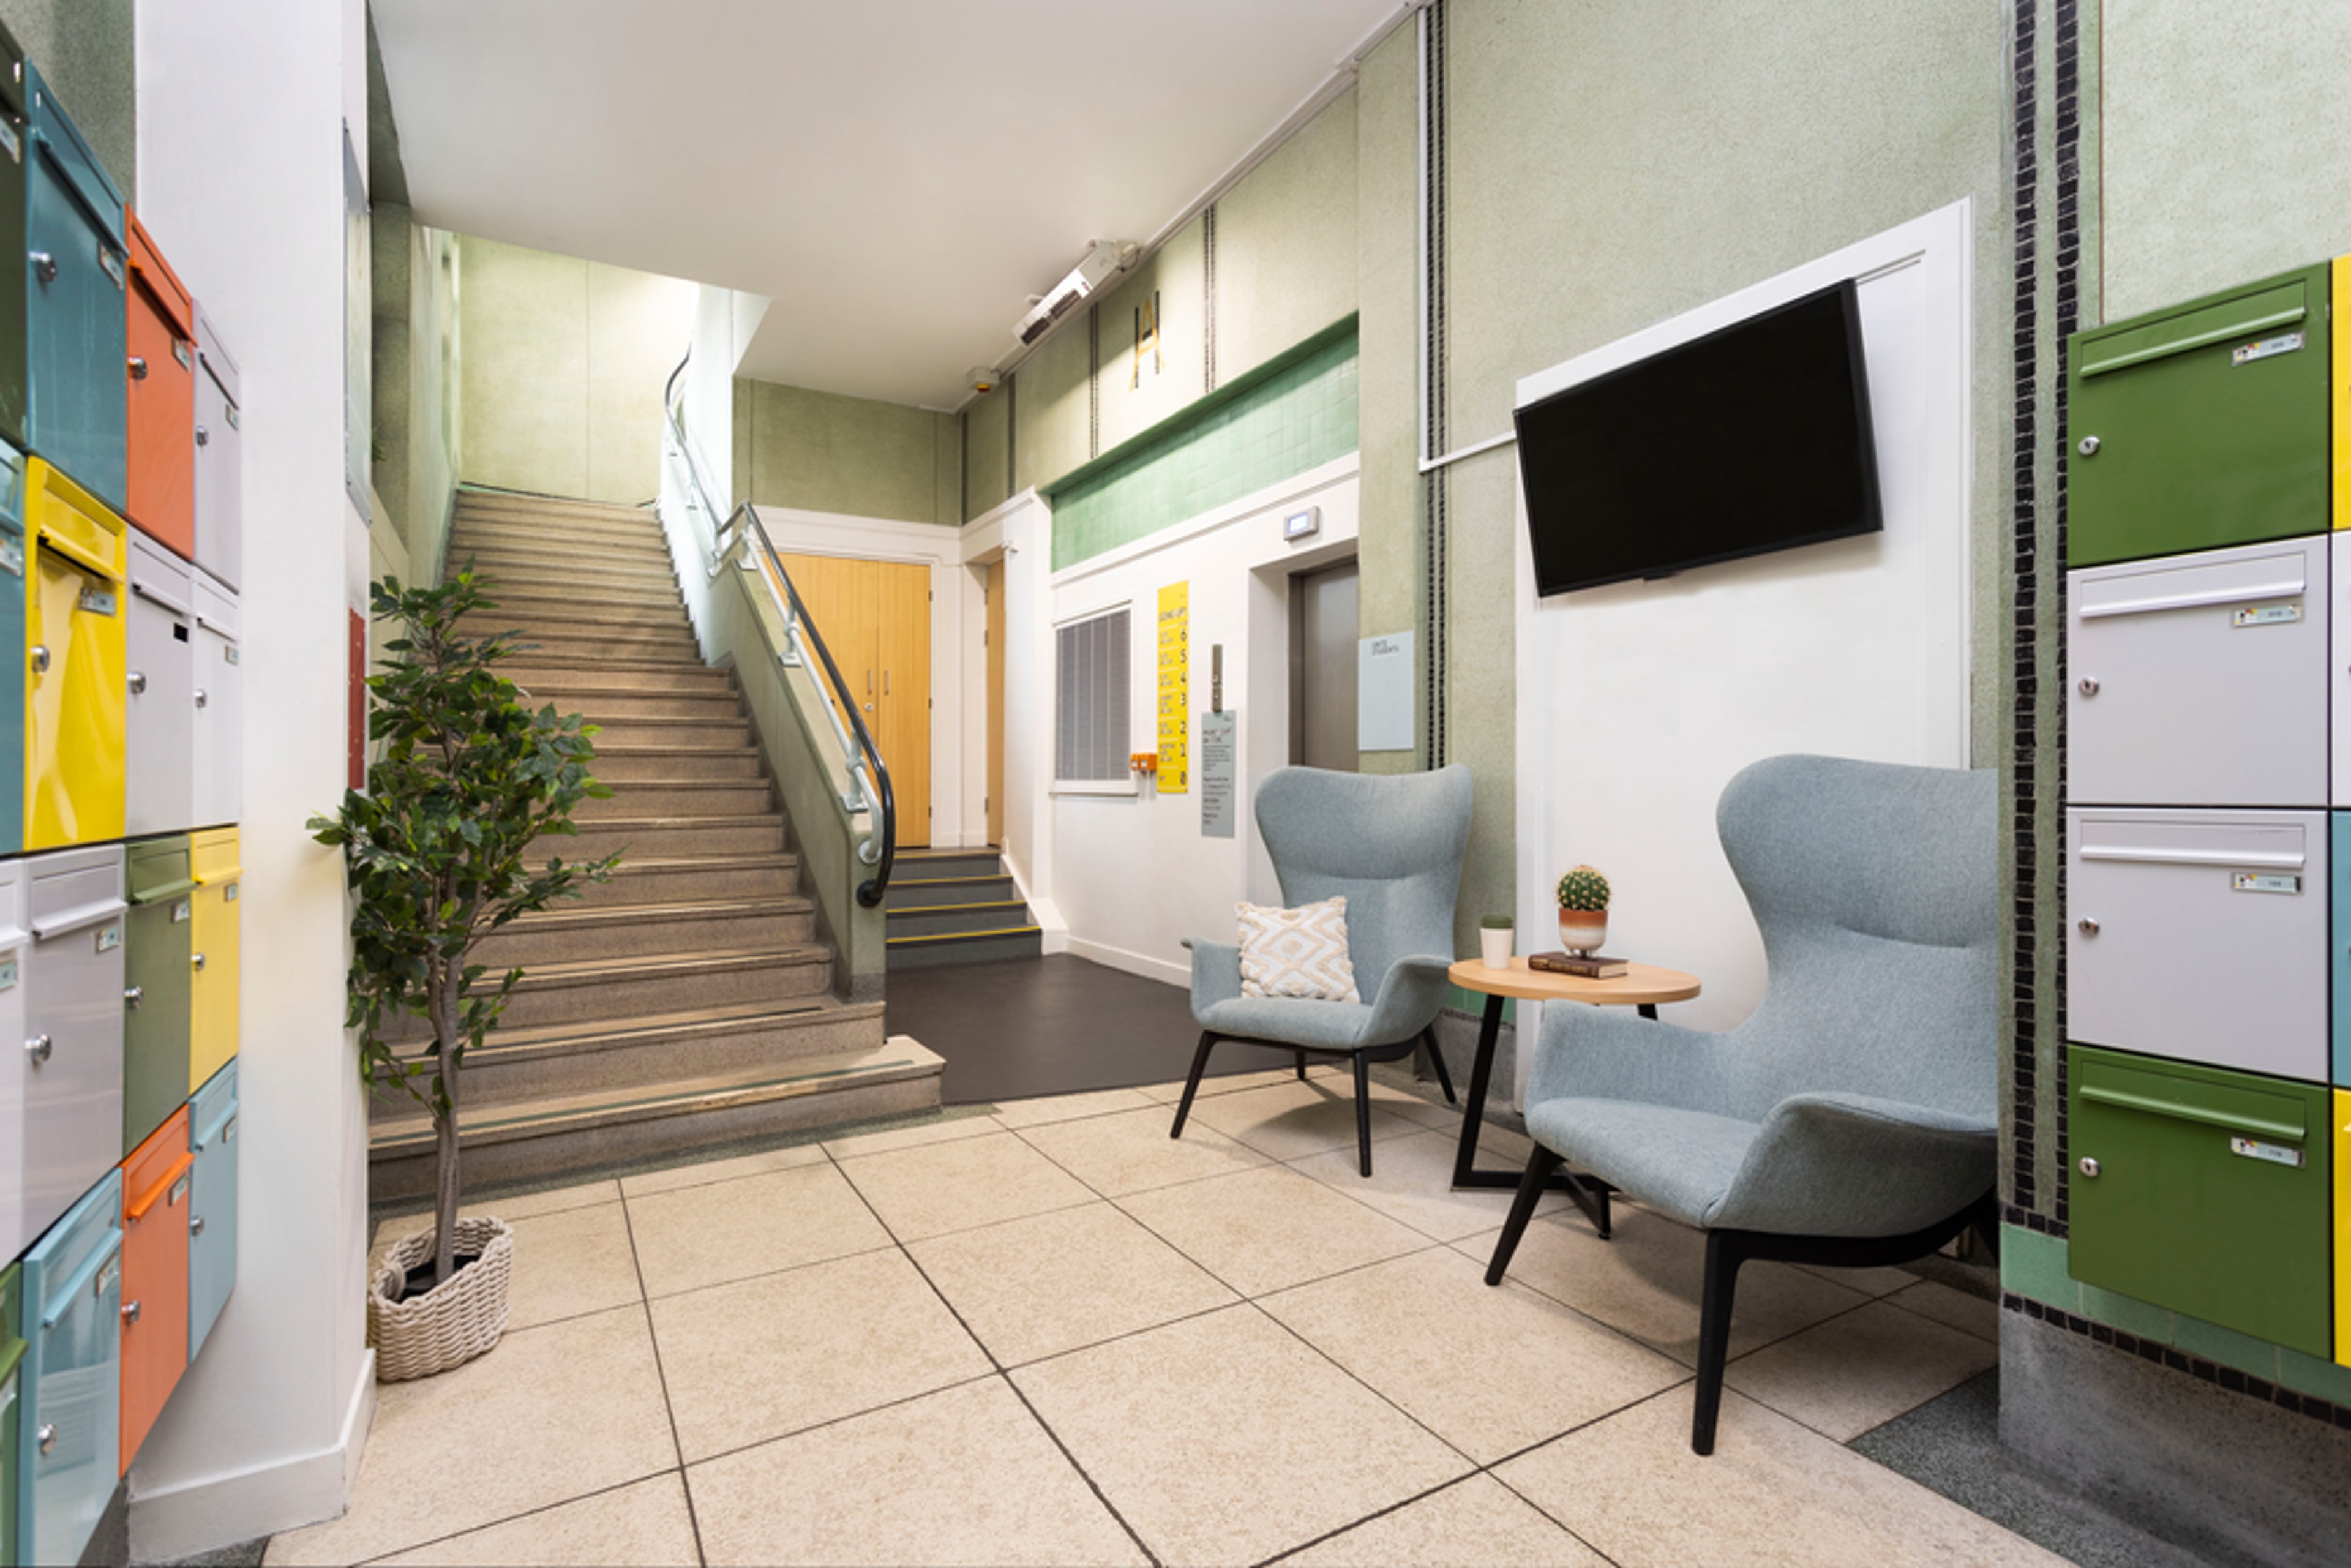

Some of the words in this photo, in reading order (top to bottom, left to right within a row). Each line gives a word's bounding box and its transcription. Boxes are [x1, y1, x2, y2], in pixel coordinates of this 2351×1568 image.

[1180, 648, 1188, 663] 5
[1180, 692, 1188, 706] 3
[1180, 721, 1188, 735] 2
[1180, 743, 1186, 757] 1
